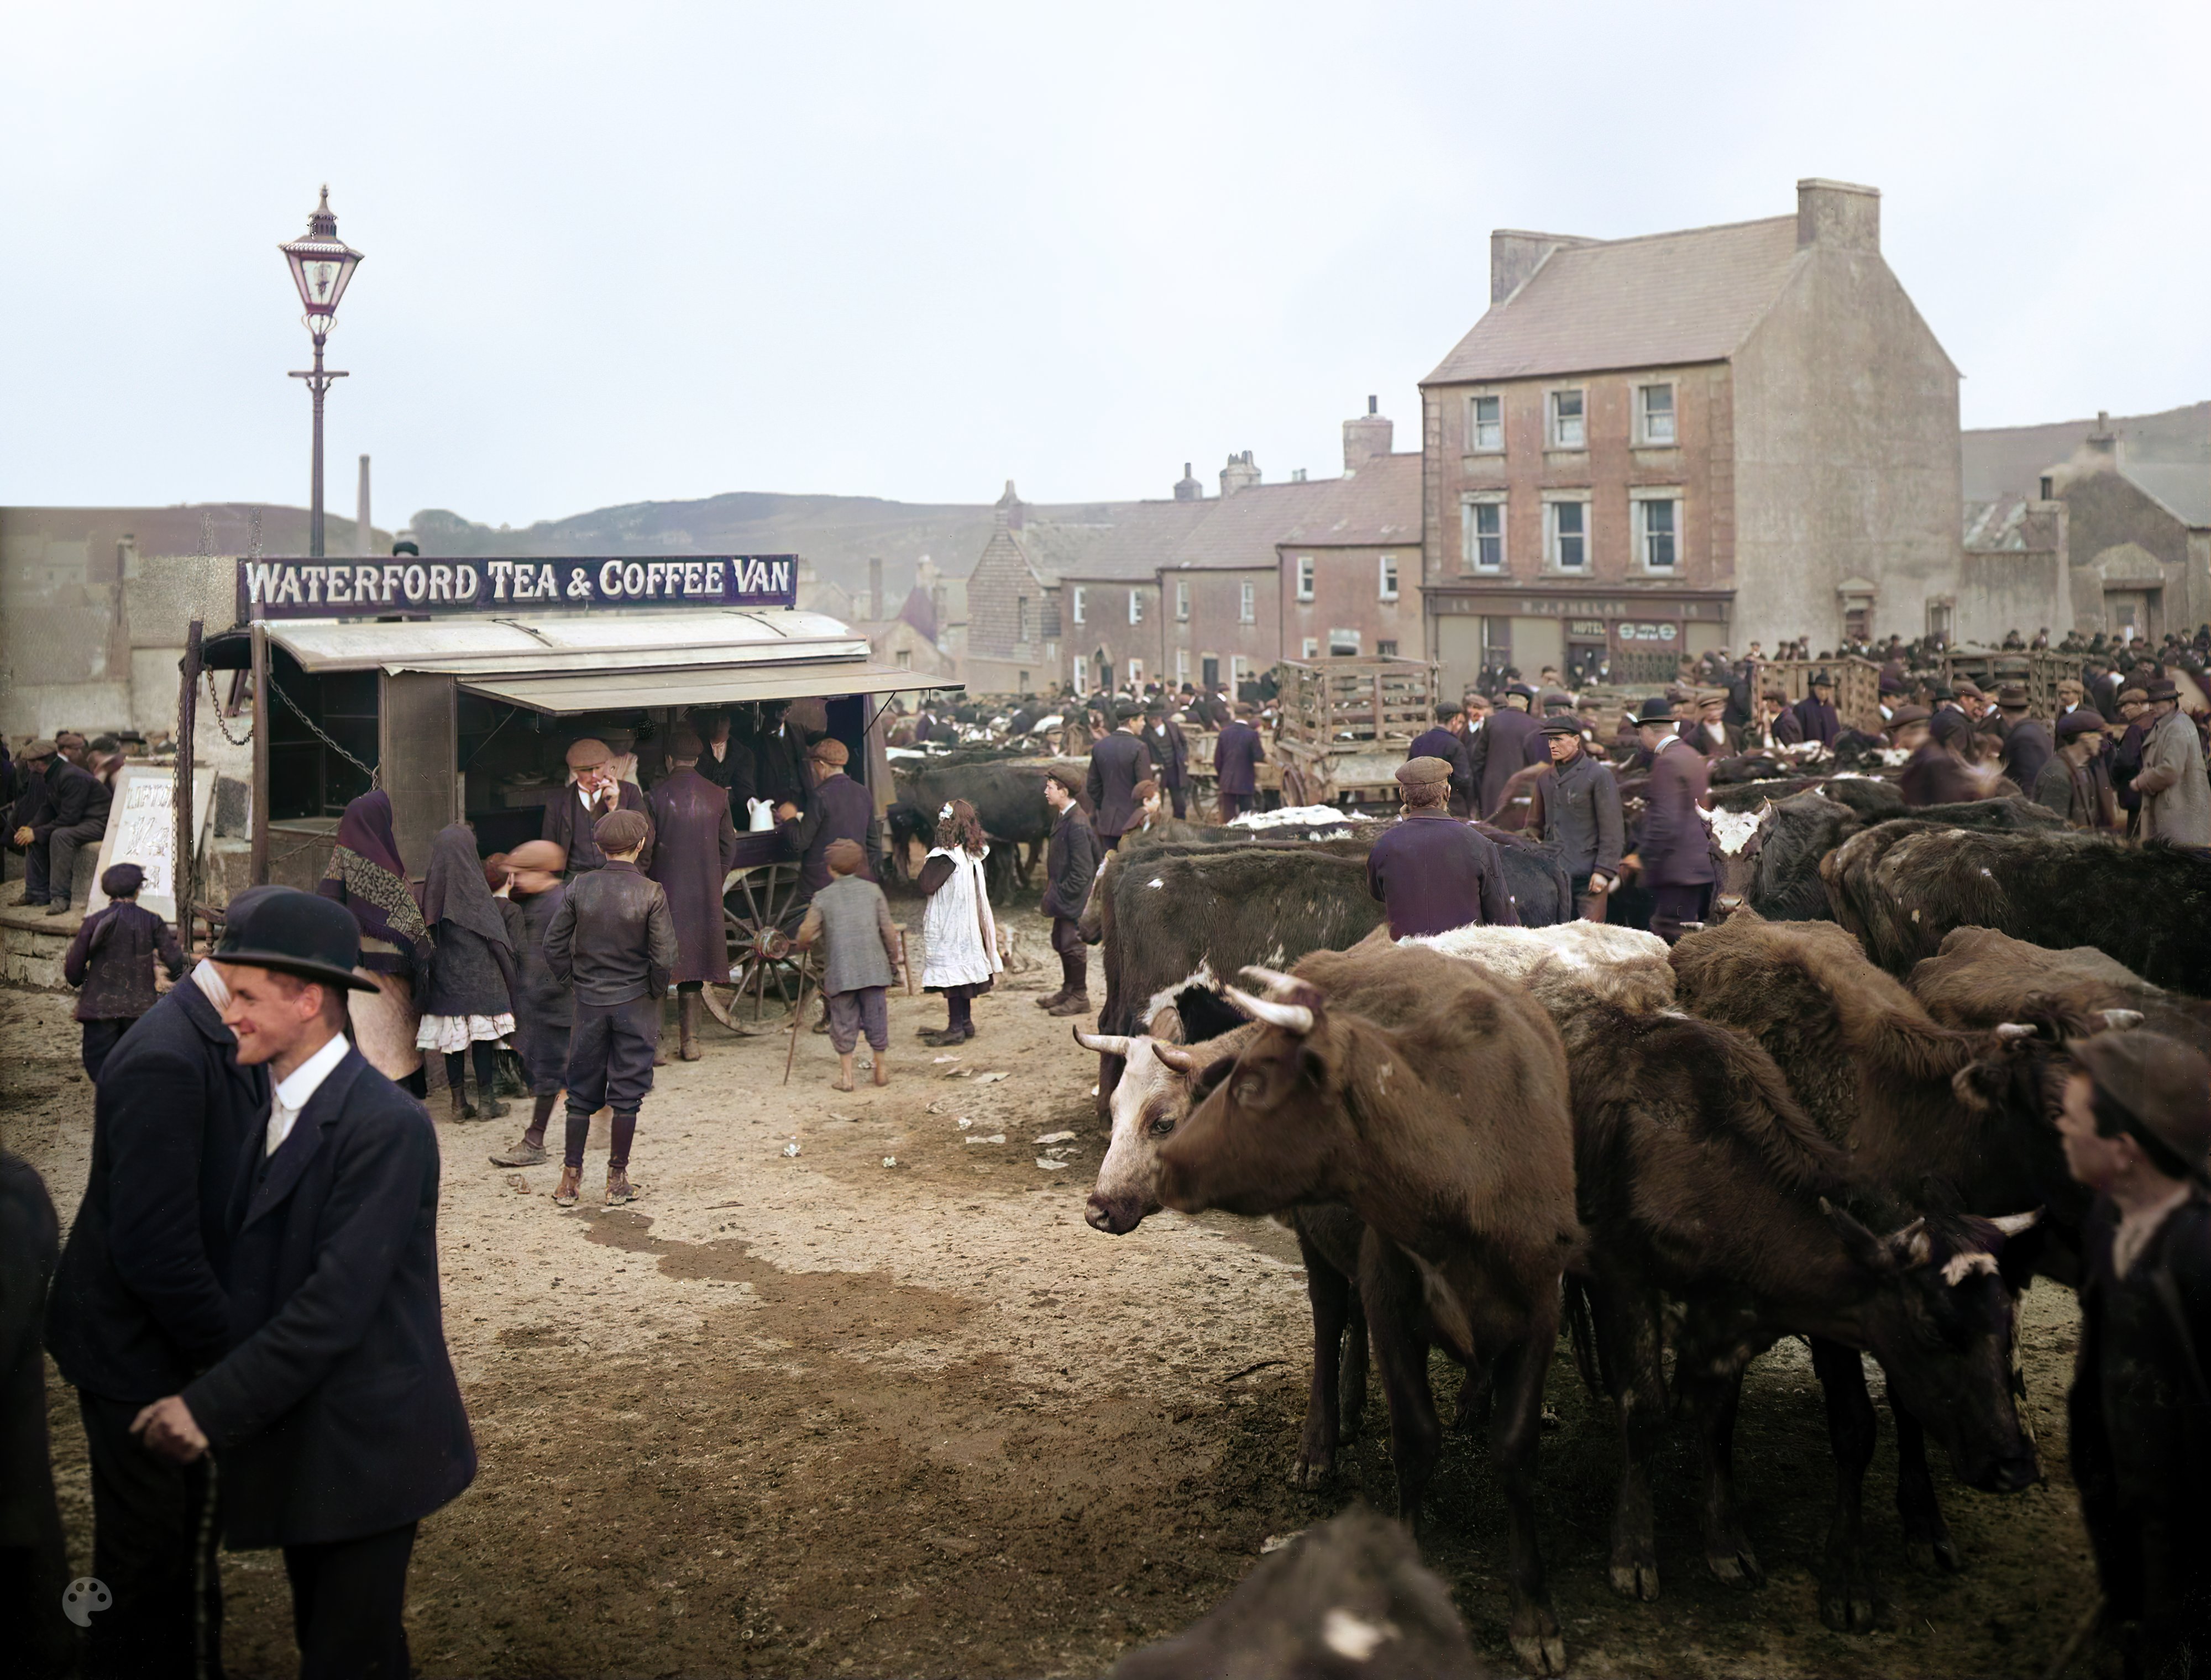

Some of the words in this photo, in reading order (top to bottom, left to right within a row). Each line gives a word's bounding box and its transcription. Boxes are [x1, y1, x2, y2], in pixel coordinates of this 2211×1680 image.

[246, 563, 478, 603] WATERFORD
[488, 561, 558, 598] TEA
[567, 568, 591, 597] &
[599, 560, 724, 595] COFFEE
[733, 559, 789, 593] VAN
[1573, 621, 1605, 634] HOTEL
